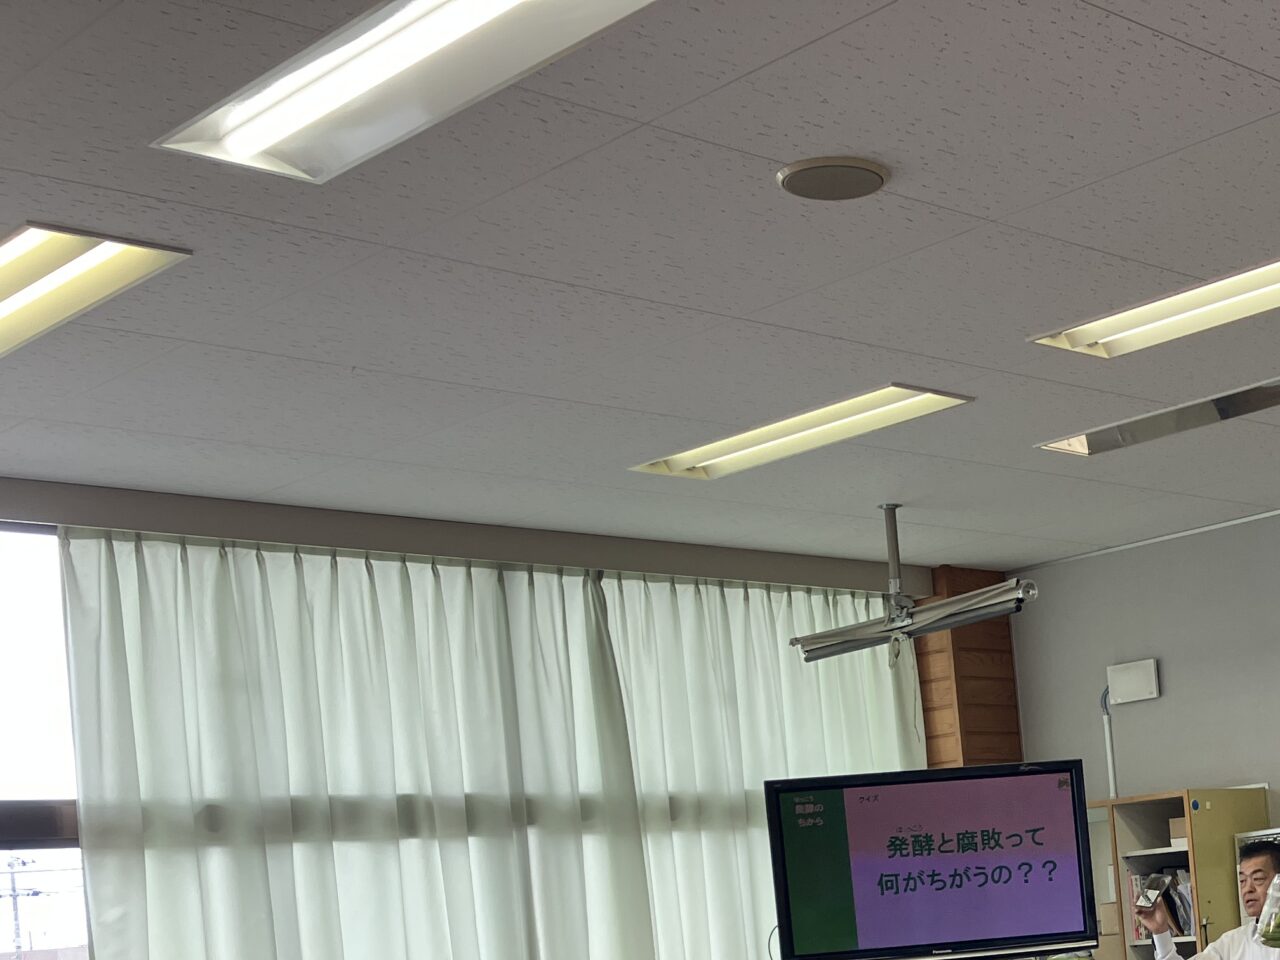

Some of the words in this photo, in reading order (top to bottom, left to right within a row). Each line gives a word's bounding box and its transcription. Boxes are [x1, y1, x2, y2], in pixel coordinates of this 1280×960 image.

[886, 826, 1045, 859] 発酵と腐敗って
